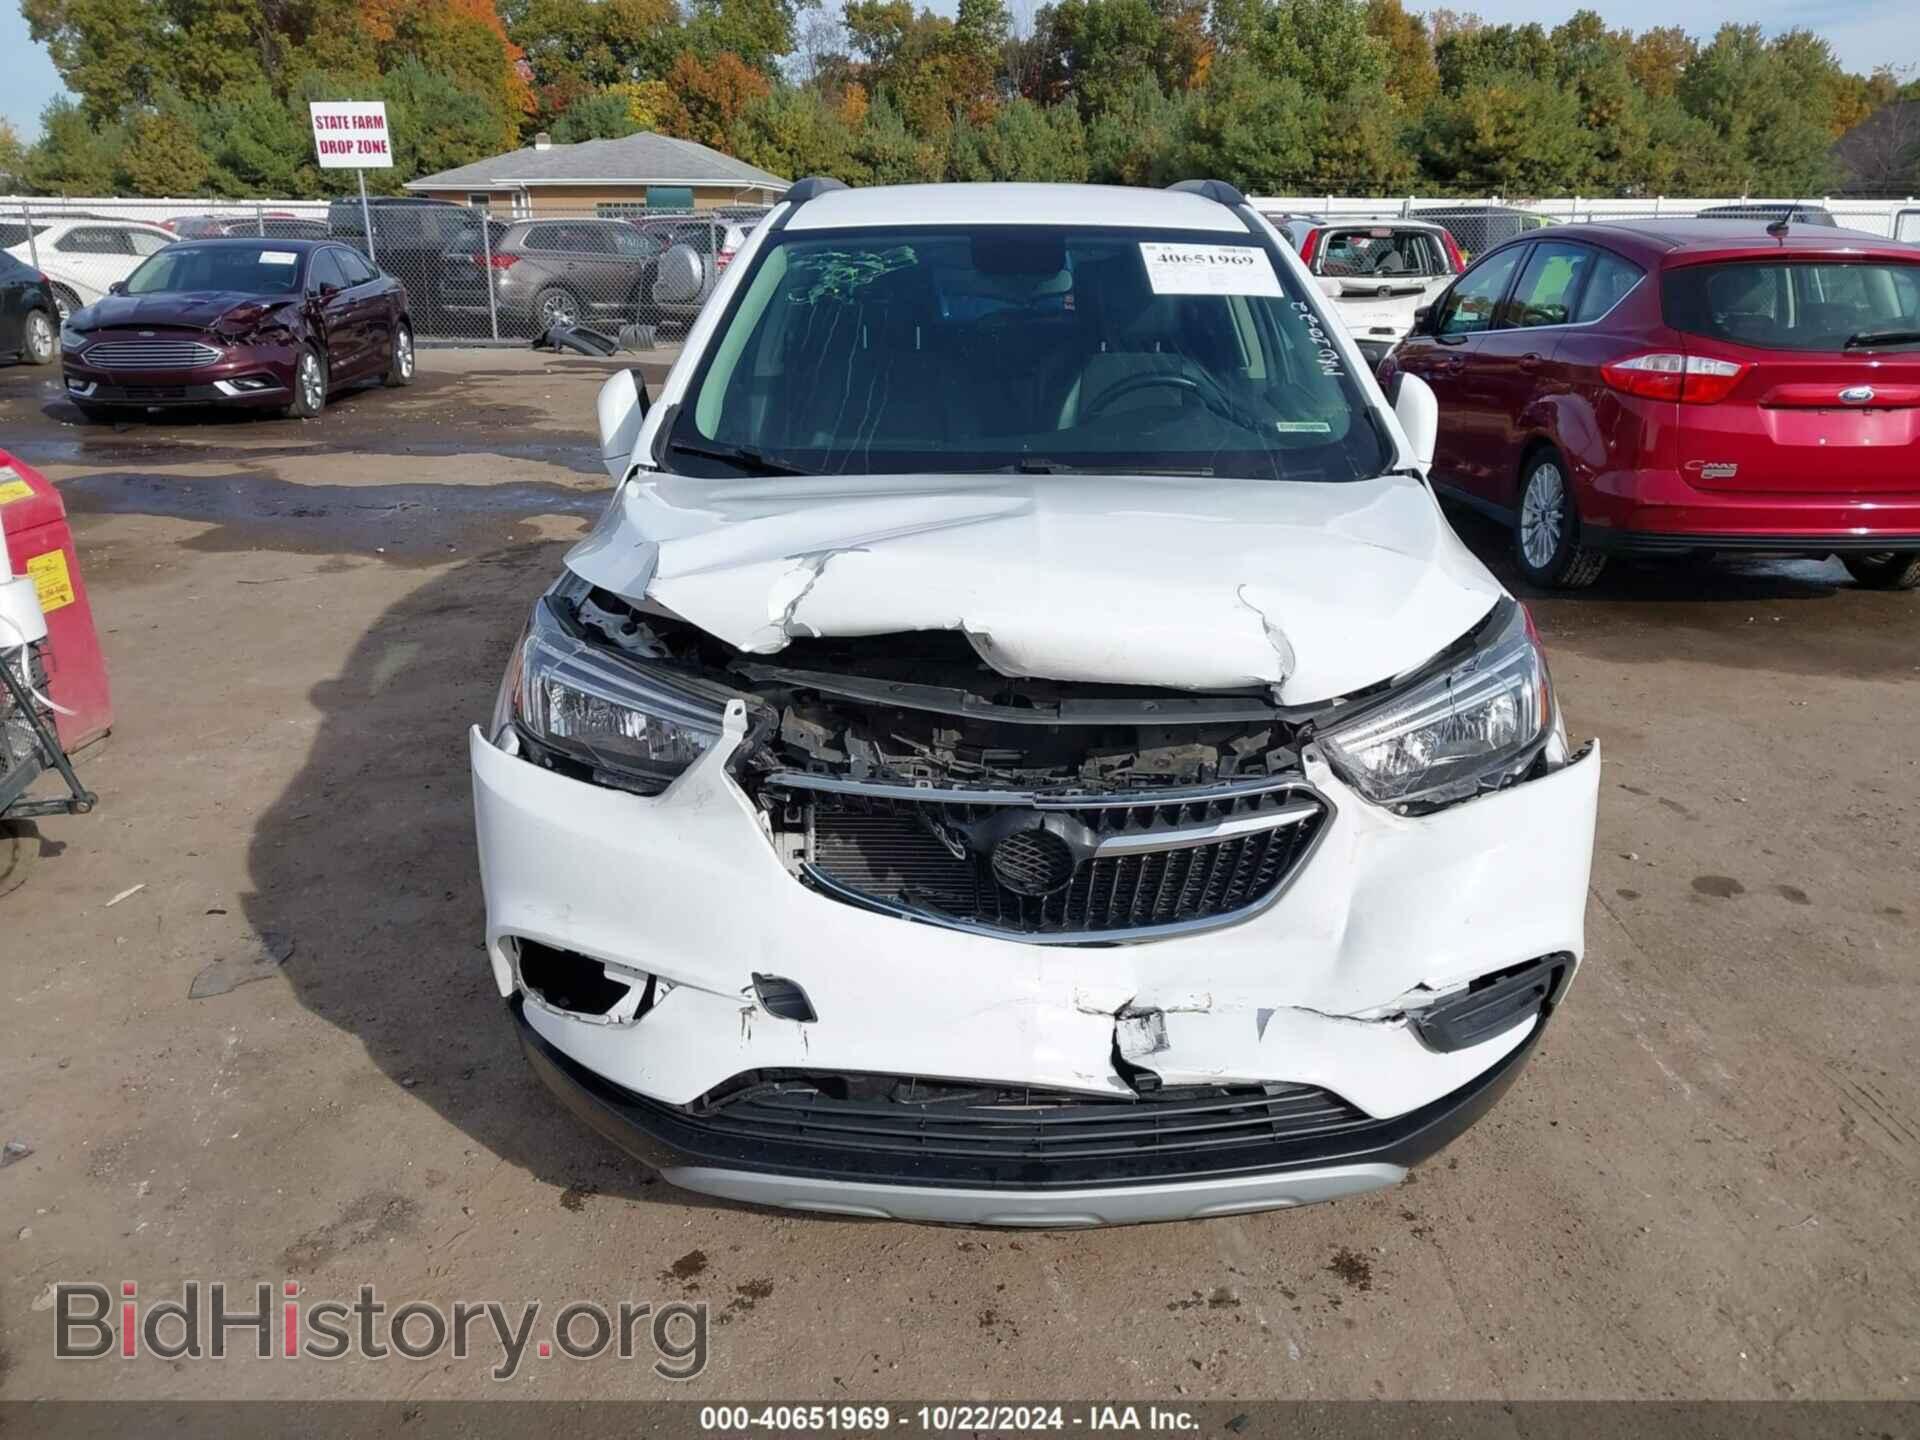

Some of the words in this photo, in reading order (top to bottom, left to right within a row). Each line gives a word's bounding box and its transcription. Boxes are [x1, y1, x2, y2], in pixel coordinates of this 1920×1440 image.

[315, 115, 351, 130] STATE
[352, 115, 385, 129] FARM
[320, 139, 354, 155] DROP
[357, 140, 389, 155] ZONE
[1157, 253, 1255, 266] 40651969
